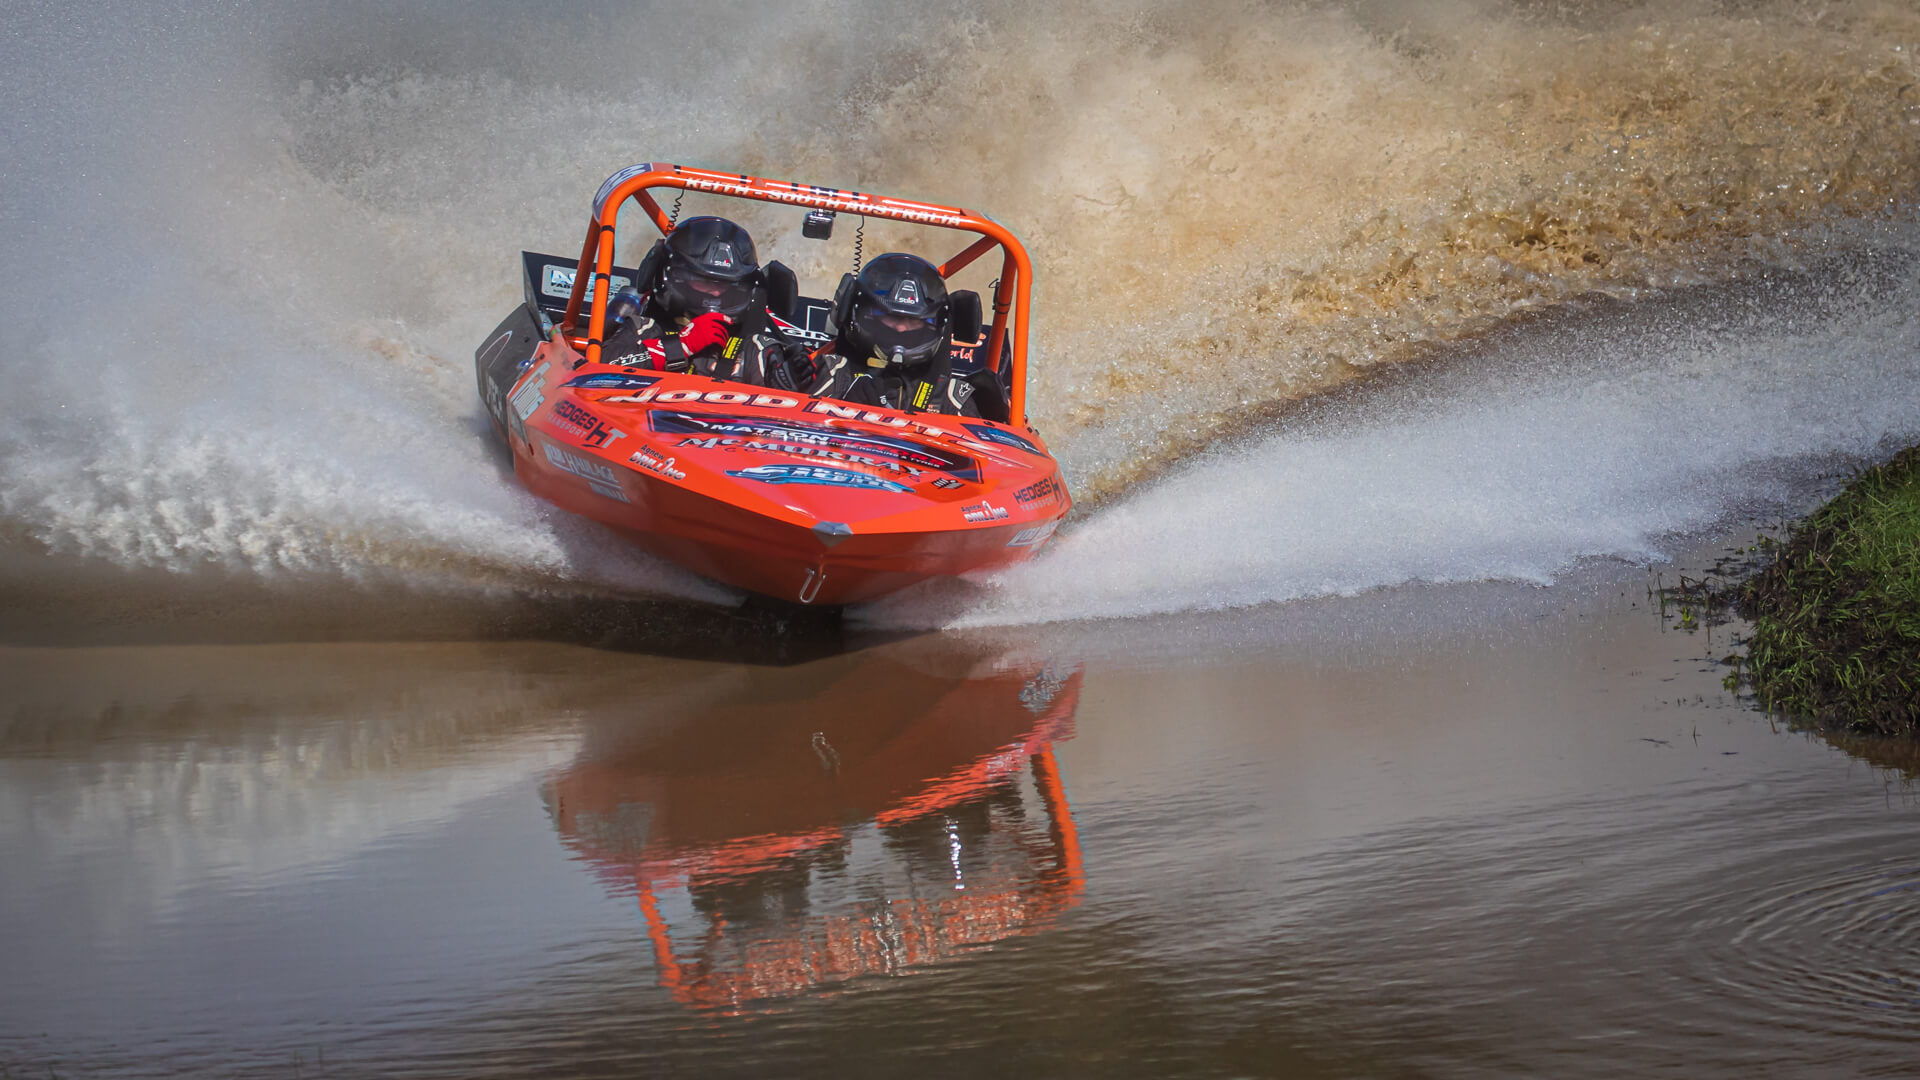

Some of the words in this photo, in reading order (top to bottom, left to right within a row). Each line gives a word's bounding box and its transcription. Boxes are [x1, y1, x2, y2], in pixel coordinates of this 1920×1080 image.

[684, 176, 750, 196] KEITH
[767, 189, 841, 209] SOUTH
[844, 200, 960, 226] AUSTRALIA
[710, 424, 829, 443] MATSON
[640, 444, 666, 460] Agnew
[1013, 478, 1052, 504] HEDGES
